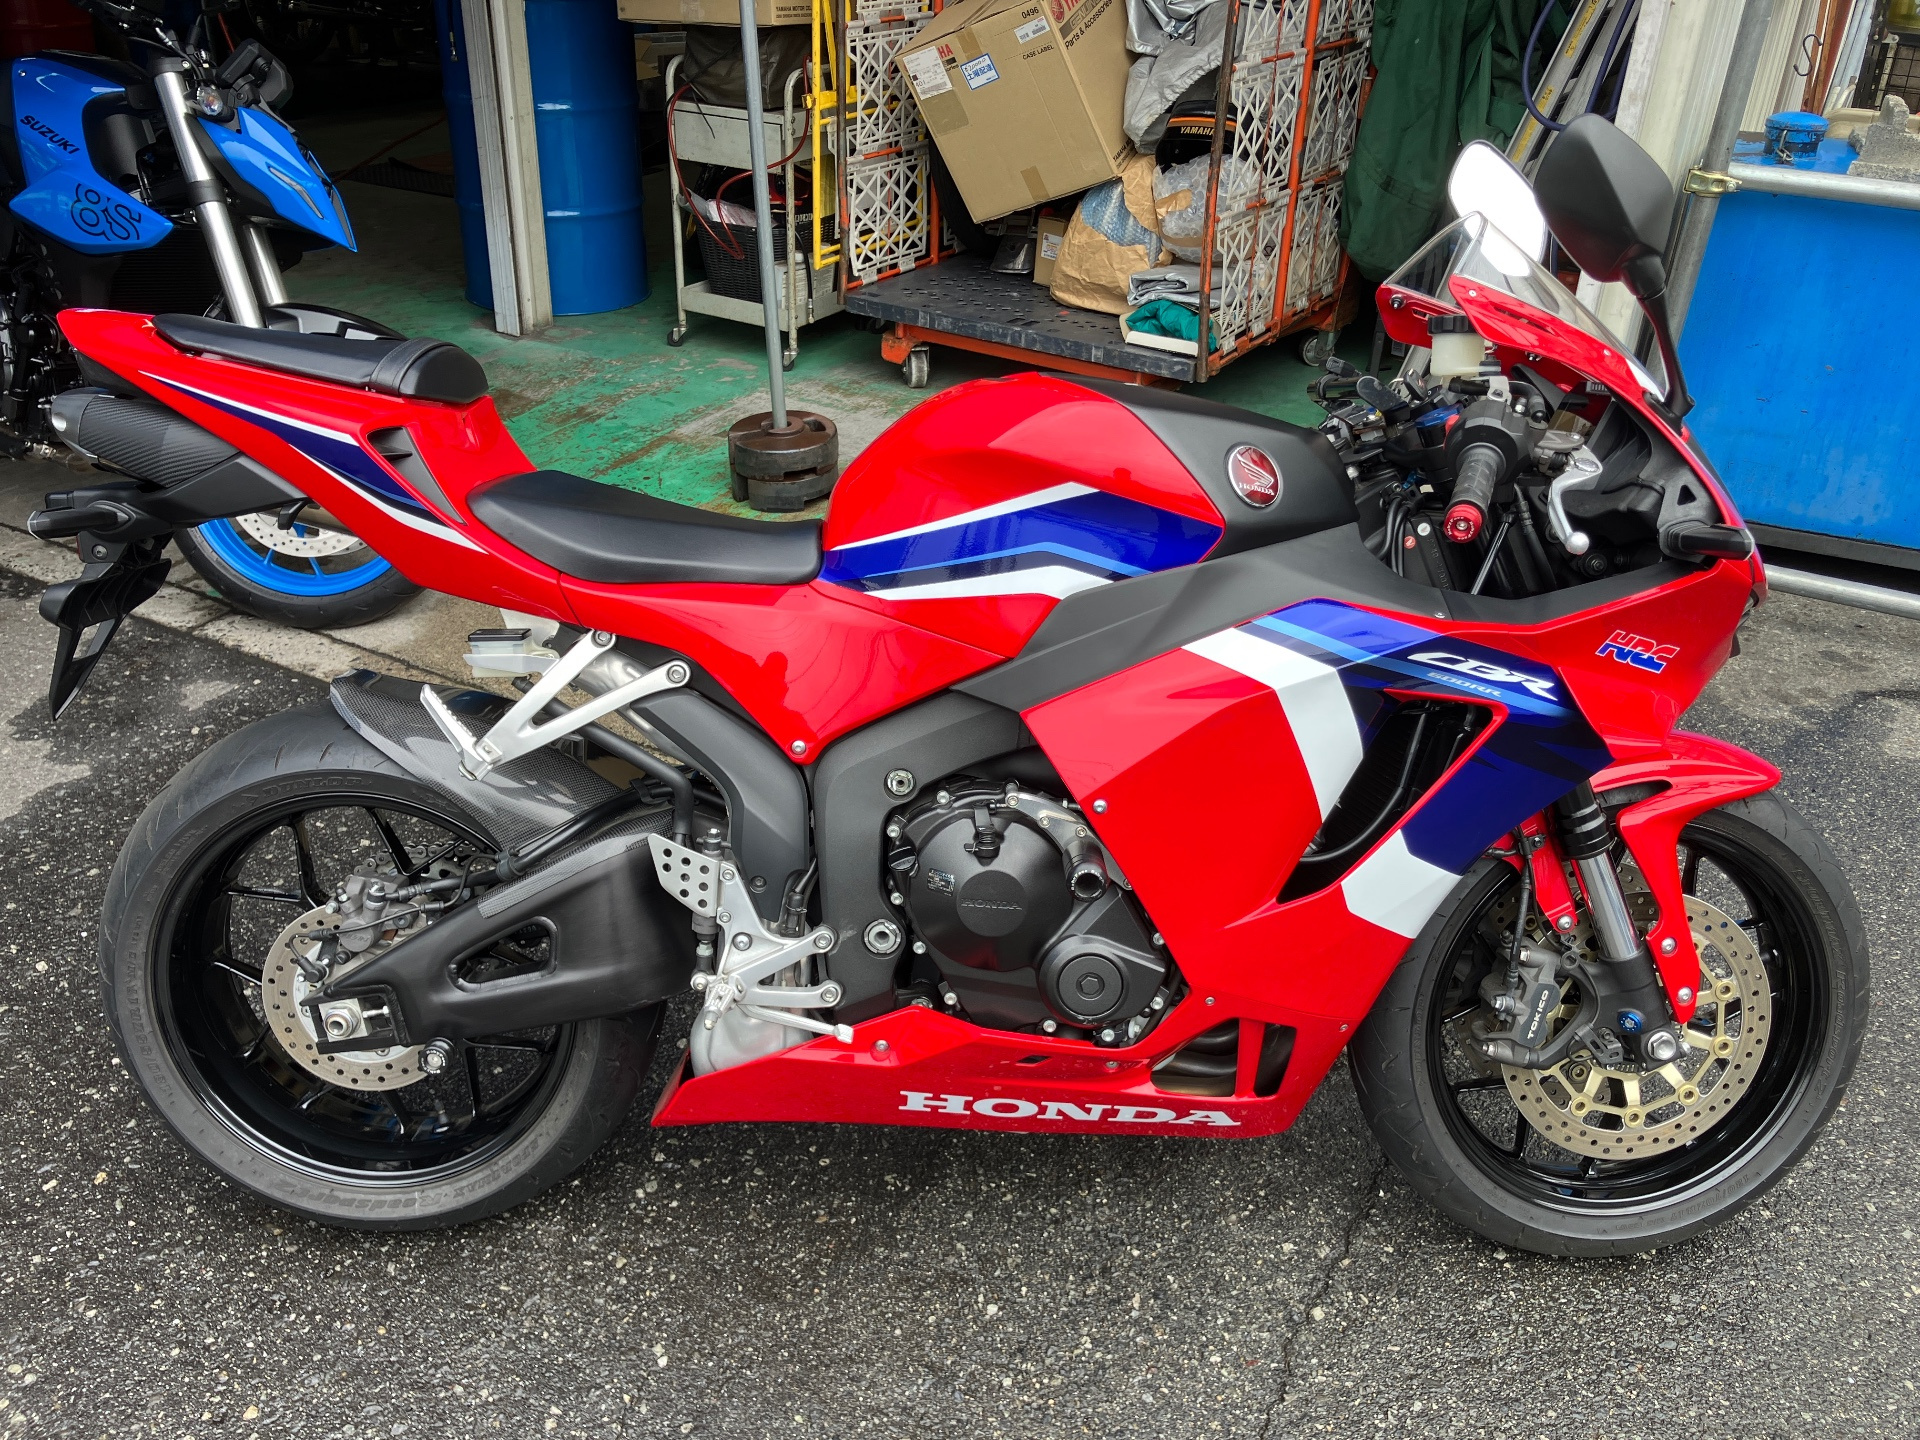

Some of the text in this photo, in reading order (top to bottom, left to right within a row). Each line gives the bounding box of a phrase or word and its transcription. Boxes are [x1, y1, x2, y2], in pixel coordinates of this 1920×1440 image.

[1021, 6, 1039, 19] 0496
[1065, 32, 1080, 49] Parts
[1079, 27, 1086, 36] &
[1084, 0, 1112, 30] Accessories
[1023, 44, 1054, 60] CASE LABEL
[20, 115, 80, 154] SUZUKI
[1238, 482, 1275, 496] HONDA
[1595, 629, 1680, 674] HRC
[1407, 652, 1558, 701] CBR
[1427, 671, 1502, 698] 600RR
[263, 776, 363, 798] DUNLOP
[961, 898, 1023, 910] HONDA
[1527, 990, 1549, 1040] TOKICO
[898, 1090, 1242, 1127] HONDA
